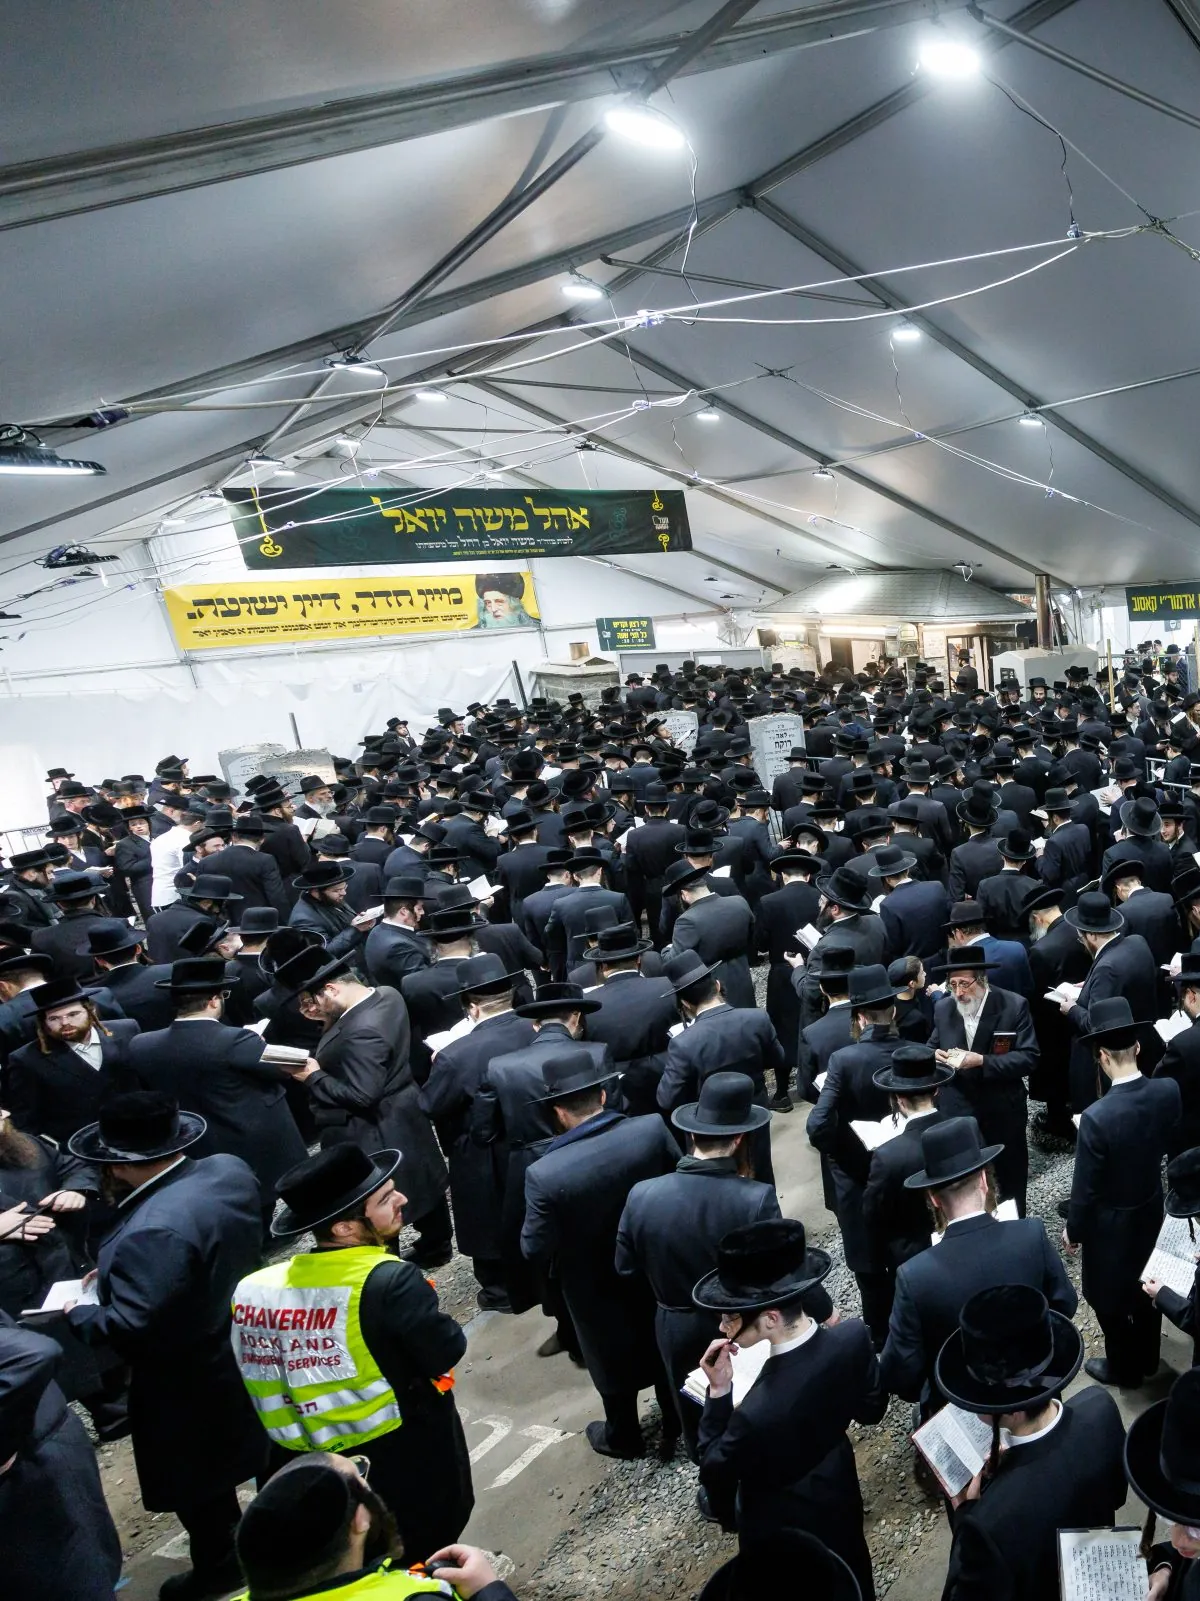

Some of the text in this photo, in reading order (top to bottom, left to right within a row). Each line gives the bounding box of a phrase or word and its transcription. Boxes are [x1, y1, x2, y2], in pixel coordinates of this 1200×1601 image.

[370, 495, 590, 534] אהל משה יואל
[460, 536, 480, 547] רחל
[488, 535, 510, 547] יואל
[511, 538, 535, 546] משה
[187, 595, 288, 620] ישועה.
[292, 592, 341, 618] דיין
[417, 588, 463, 611] מיין
[1132, 596, 1157, 612] קאסוב
[233, 1304, 338, 1330] CHAVERIM
[288, 1355, 341, 1372] SERVICES
